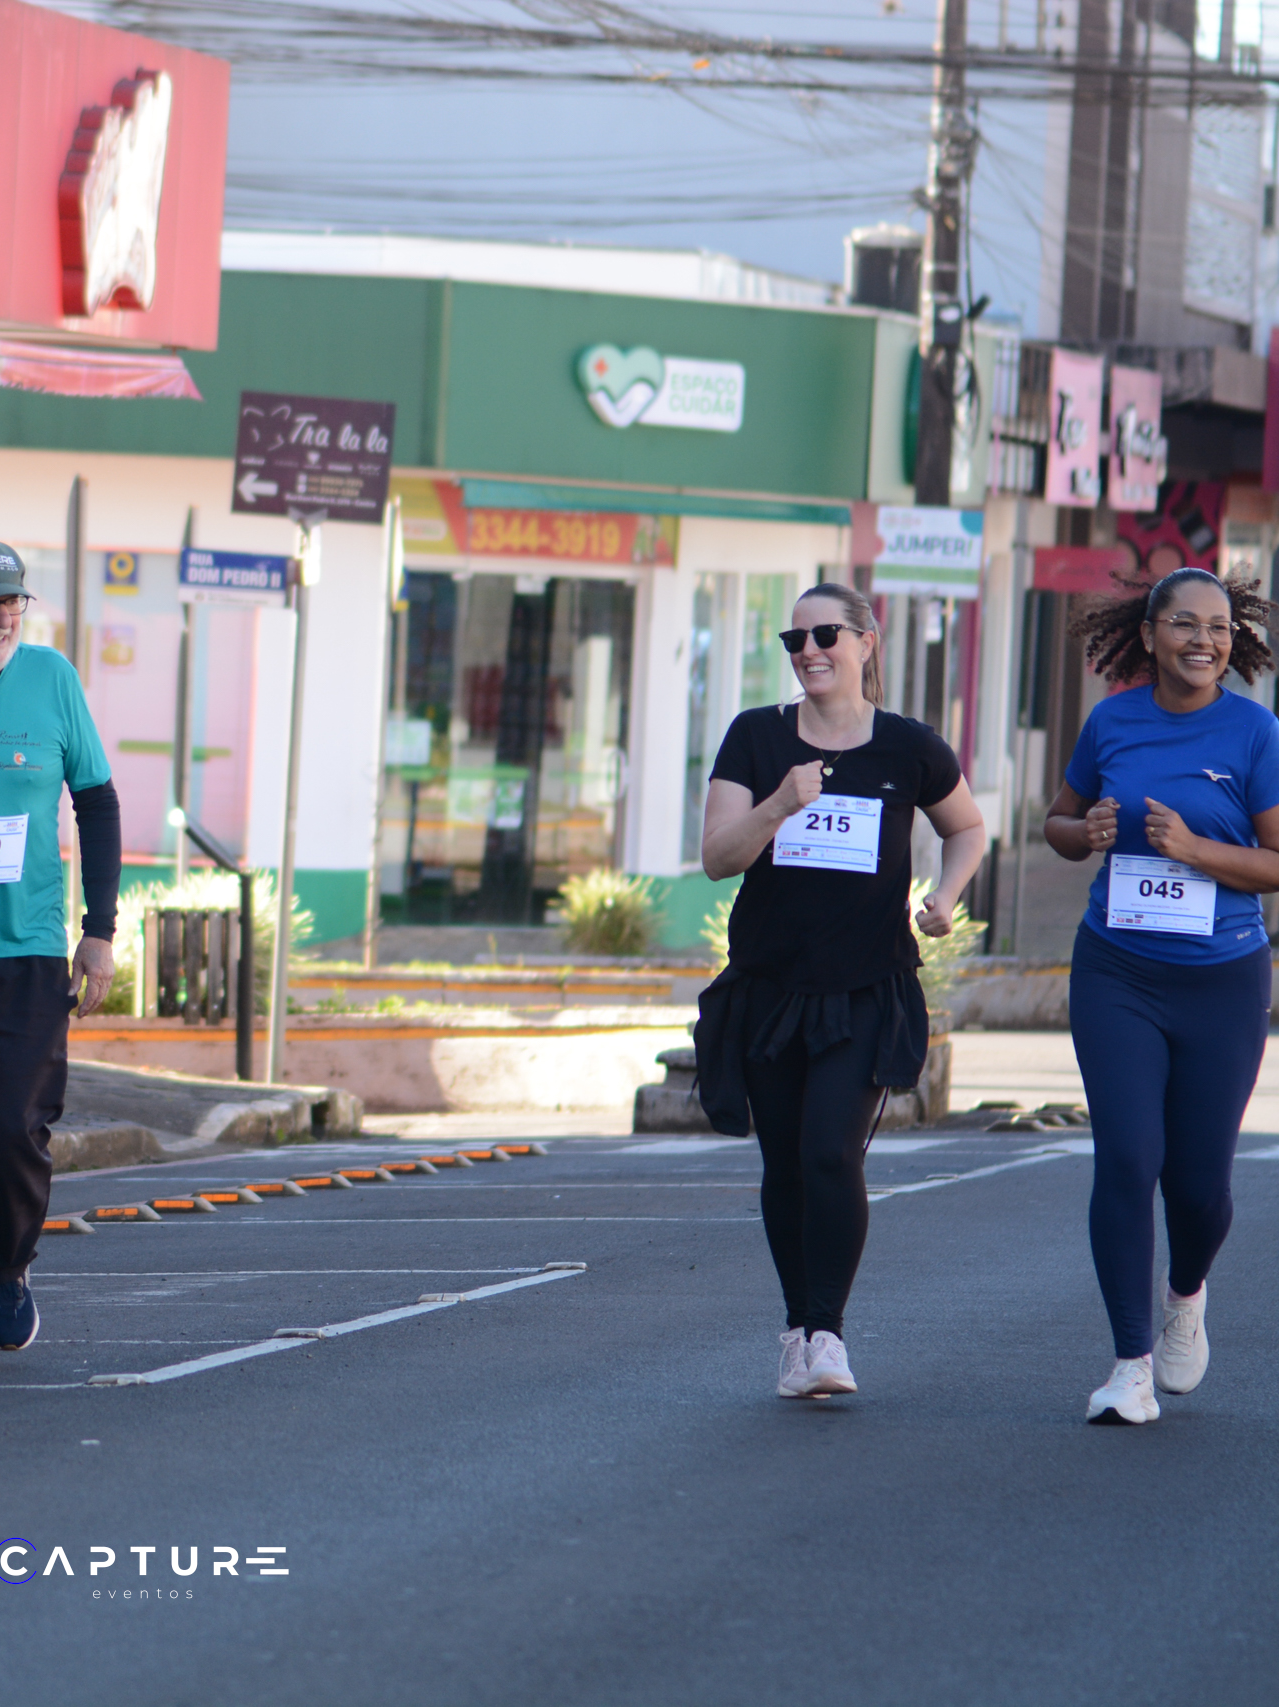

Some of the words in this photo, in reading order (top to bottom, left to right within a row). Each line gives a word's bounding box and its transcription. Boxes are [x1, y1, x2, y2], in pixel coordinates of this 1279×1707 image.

[670, 372, 738, 396] ESPAÇO
[669, 393, 736, 418] CUIDAR
[290, 415, 330, 448] Tra
[338, 423, 361, 451] la
[366, 423, 388, 454] la
[472, 512, 621, 558] 3344-3919
[189, 553, 213, 566] RUA
[188, 567, 220, 584] DOM
[223, 569, 268, 587] PEDRO
[805, 813, 851, 833] 215
[1139, 879, 1184, 900] 045
